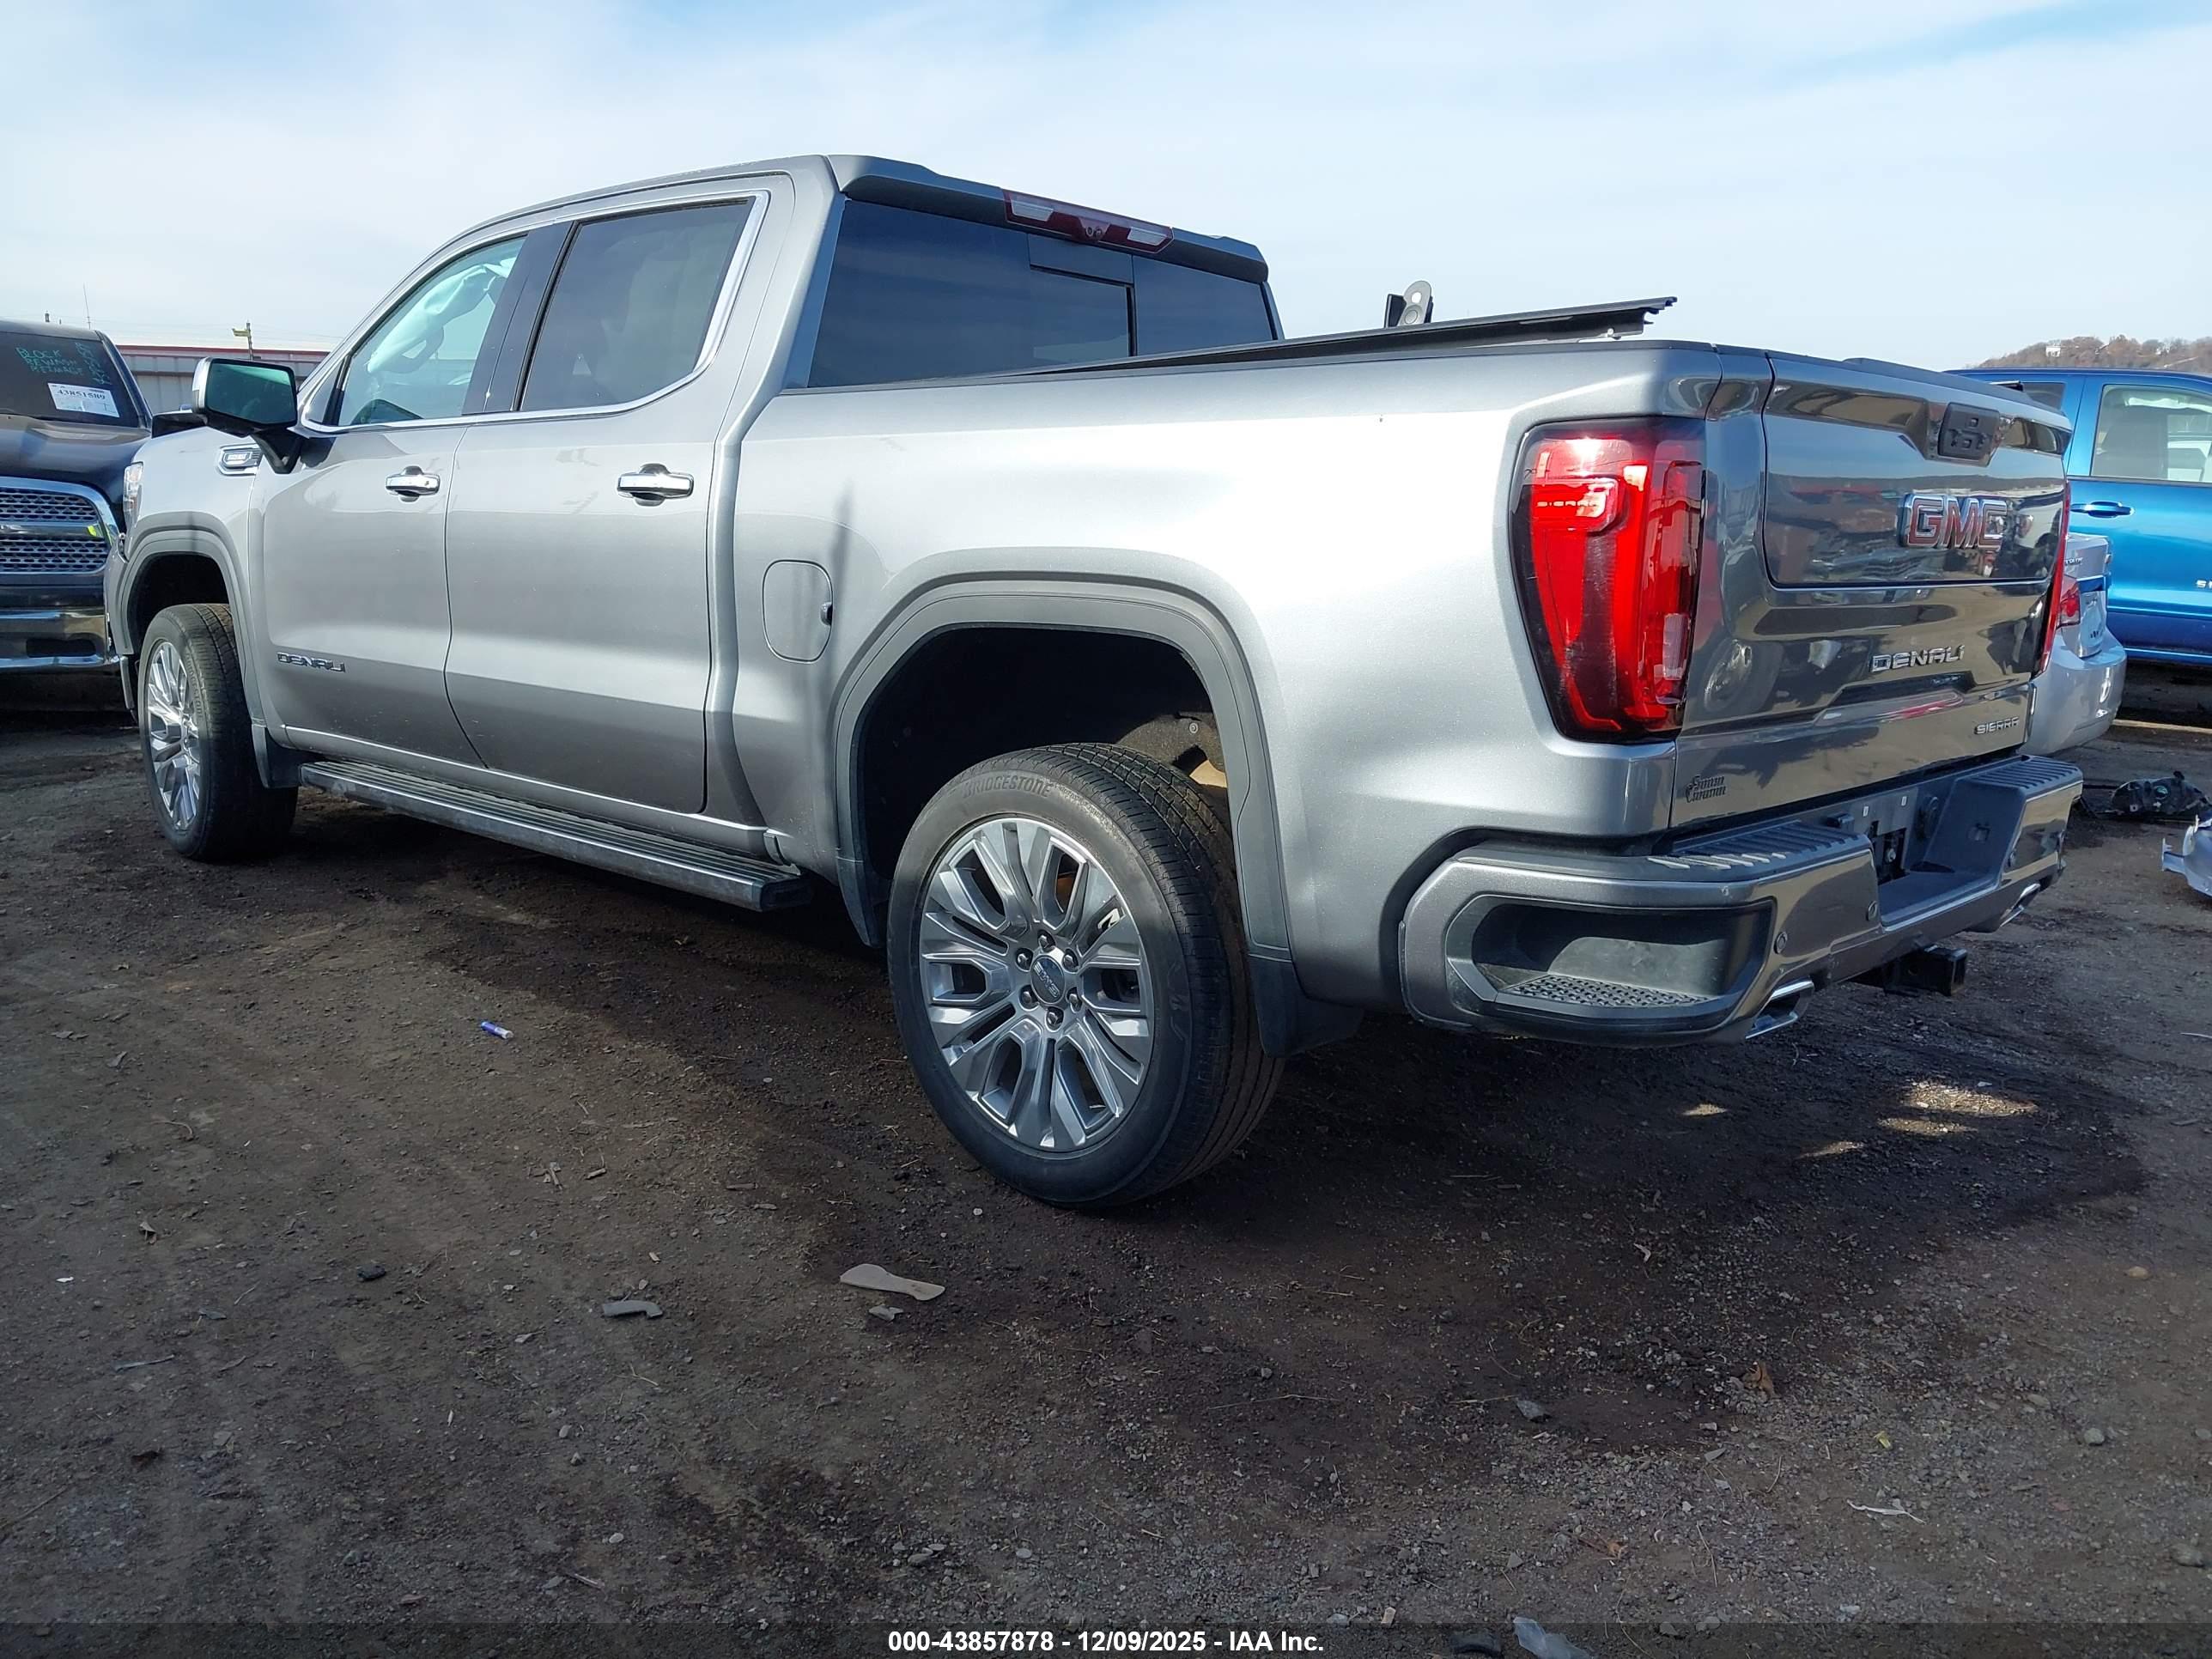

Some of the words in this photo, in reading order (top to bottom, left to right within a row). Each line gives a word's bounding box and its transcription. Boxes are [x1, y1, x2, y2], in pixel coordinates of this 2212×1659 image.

[1899, 494, 2008, 550] GMC
[276, 652, 346, 673] DENALI
[1871, 644, 1966, 673] DENALI
[1975, 717, 2021, 735] SIERRA
[962, 774, 1055, 799] BRIDGESTONE
